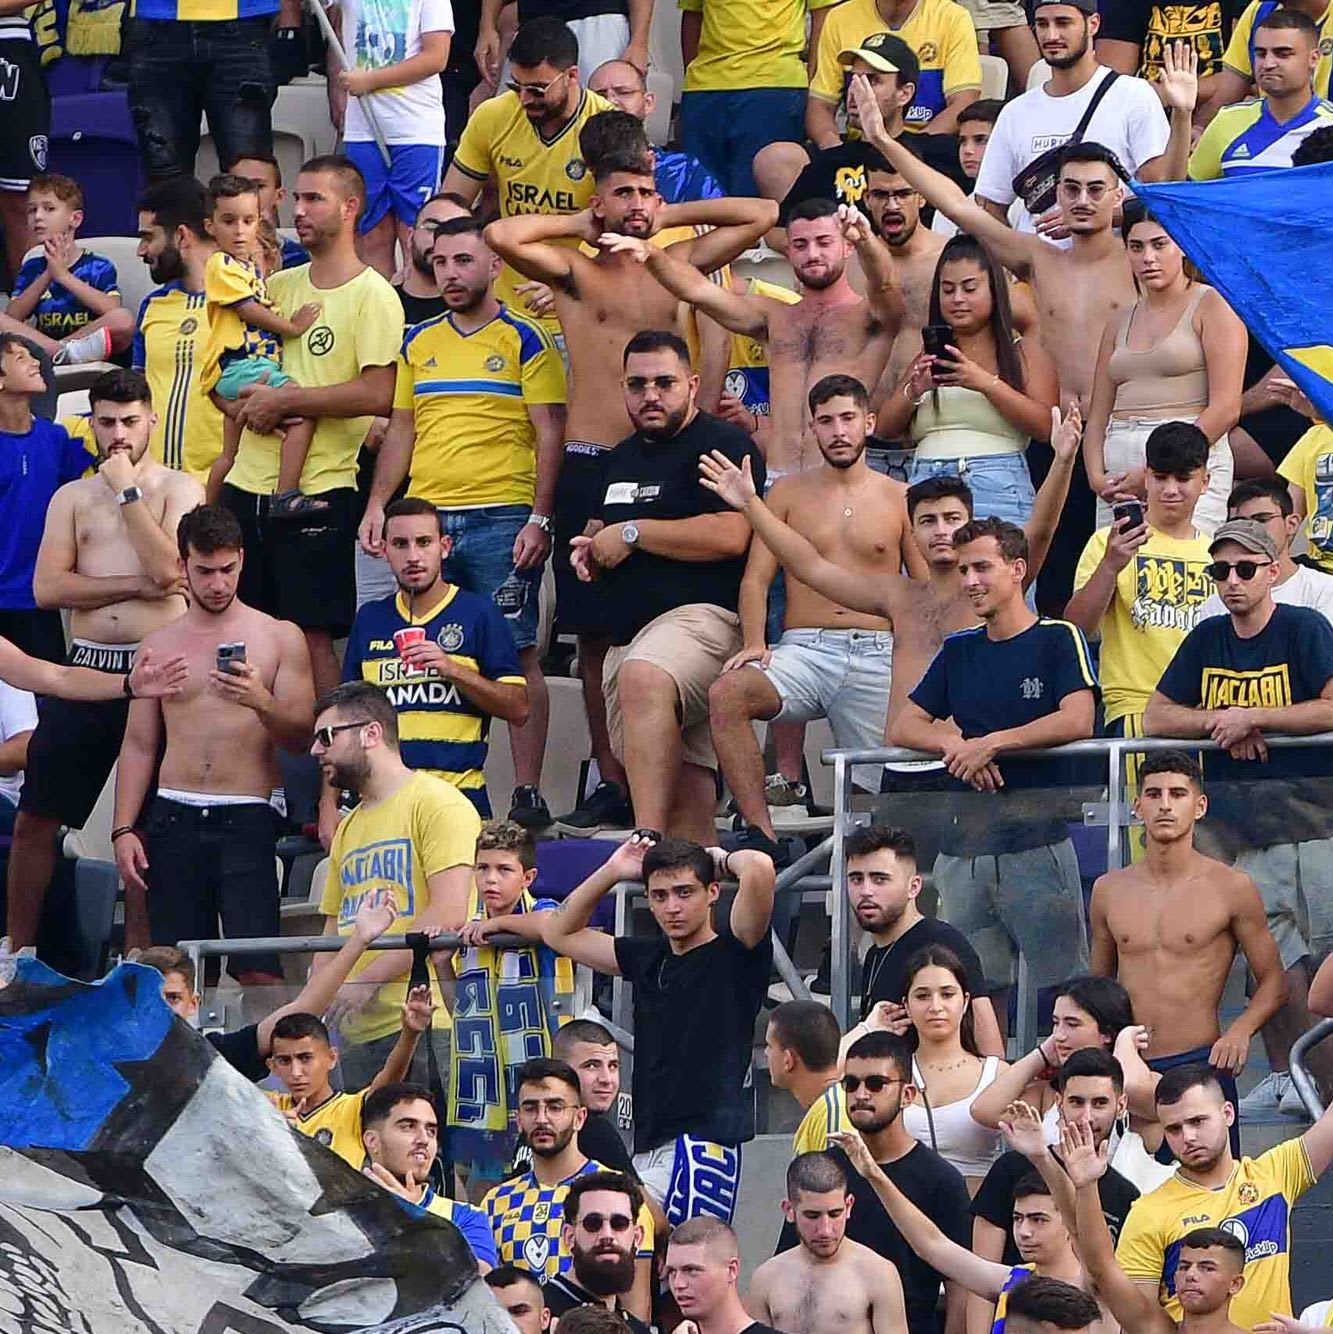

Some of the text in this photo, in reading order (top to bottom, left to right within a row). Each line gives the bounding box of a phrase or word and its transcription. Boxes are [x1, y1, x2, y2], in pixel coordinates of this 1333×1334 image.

[501, 156, 523, 168] FILA
[508, 181, 581, 211] ISRAEL
[369, 640, 395, 651] FILA
[73, 646, 124, 671] CALVIN
[384, 686, 462, 706] ANADA
[619, 1096, 632, 1118] 20
[1182, 1214, 1210, 1227] FILA
